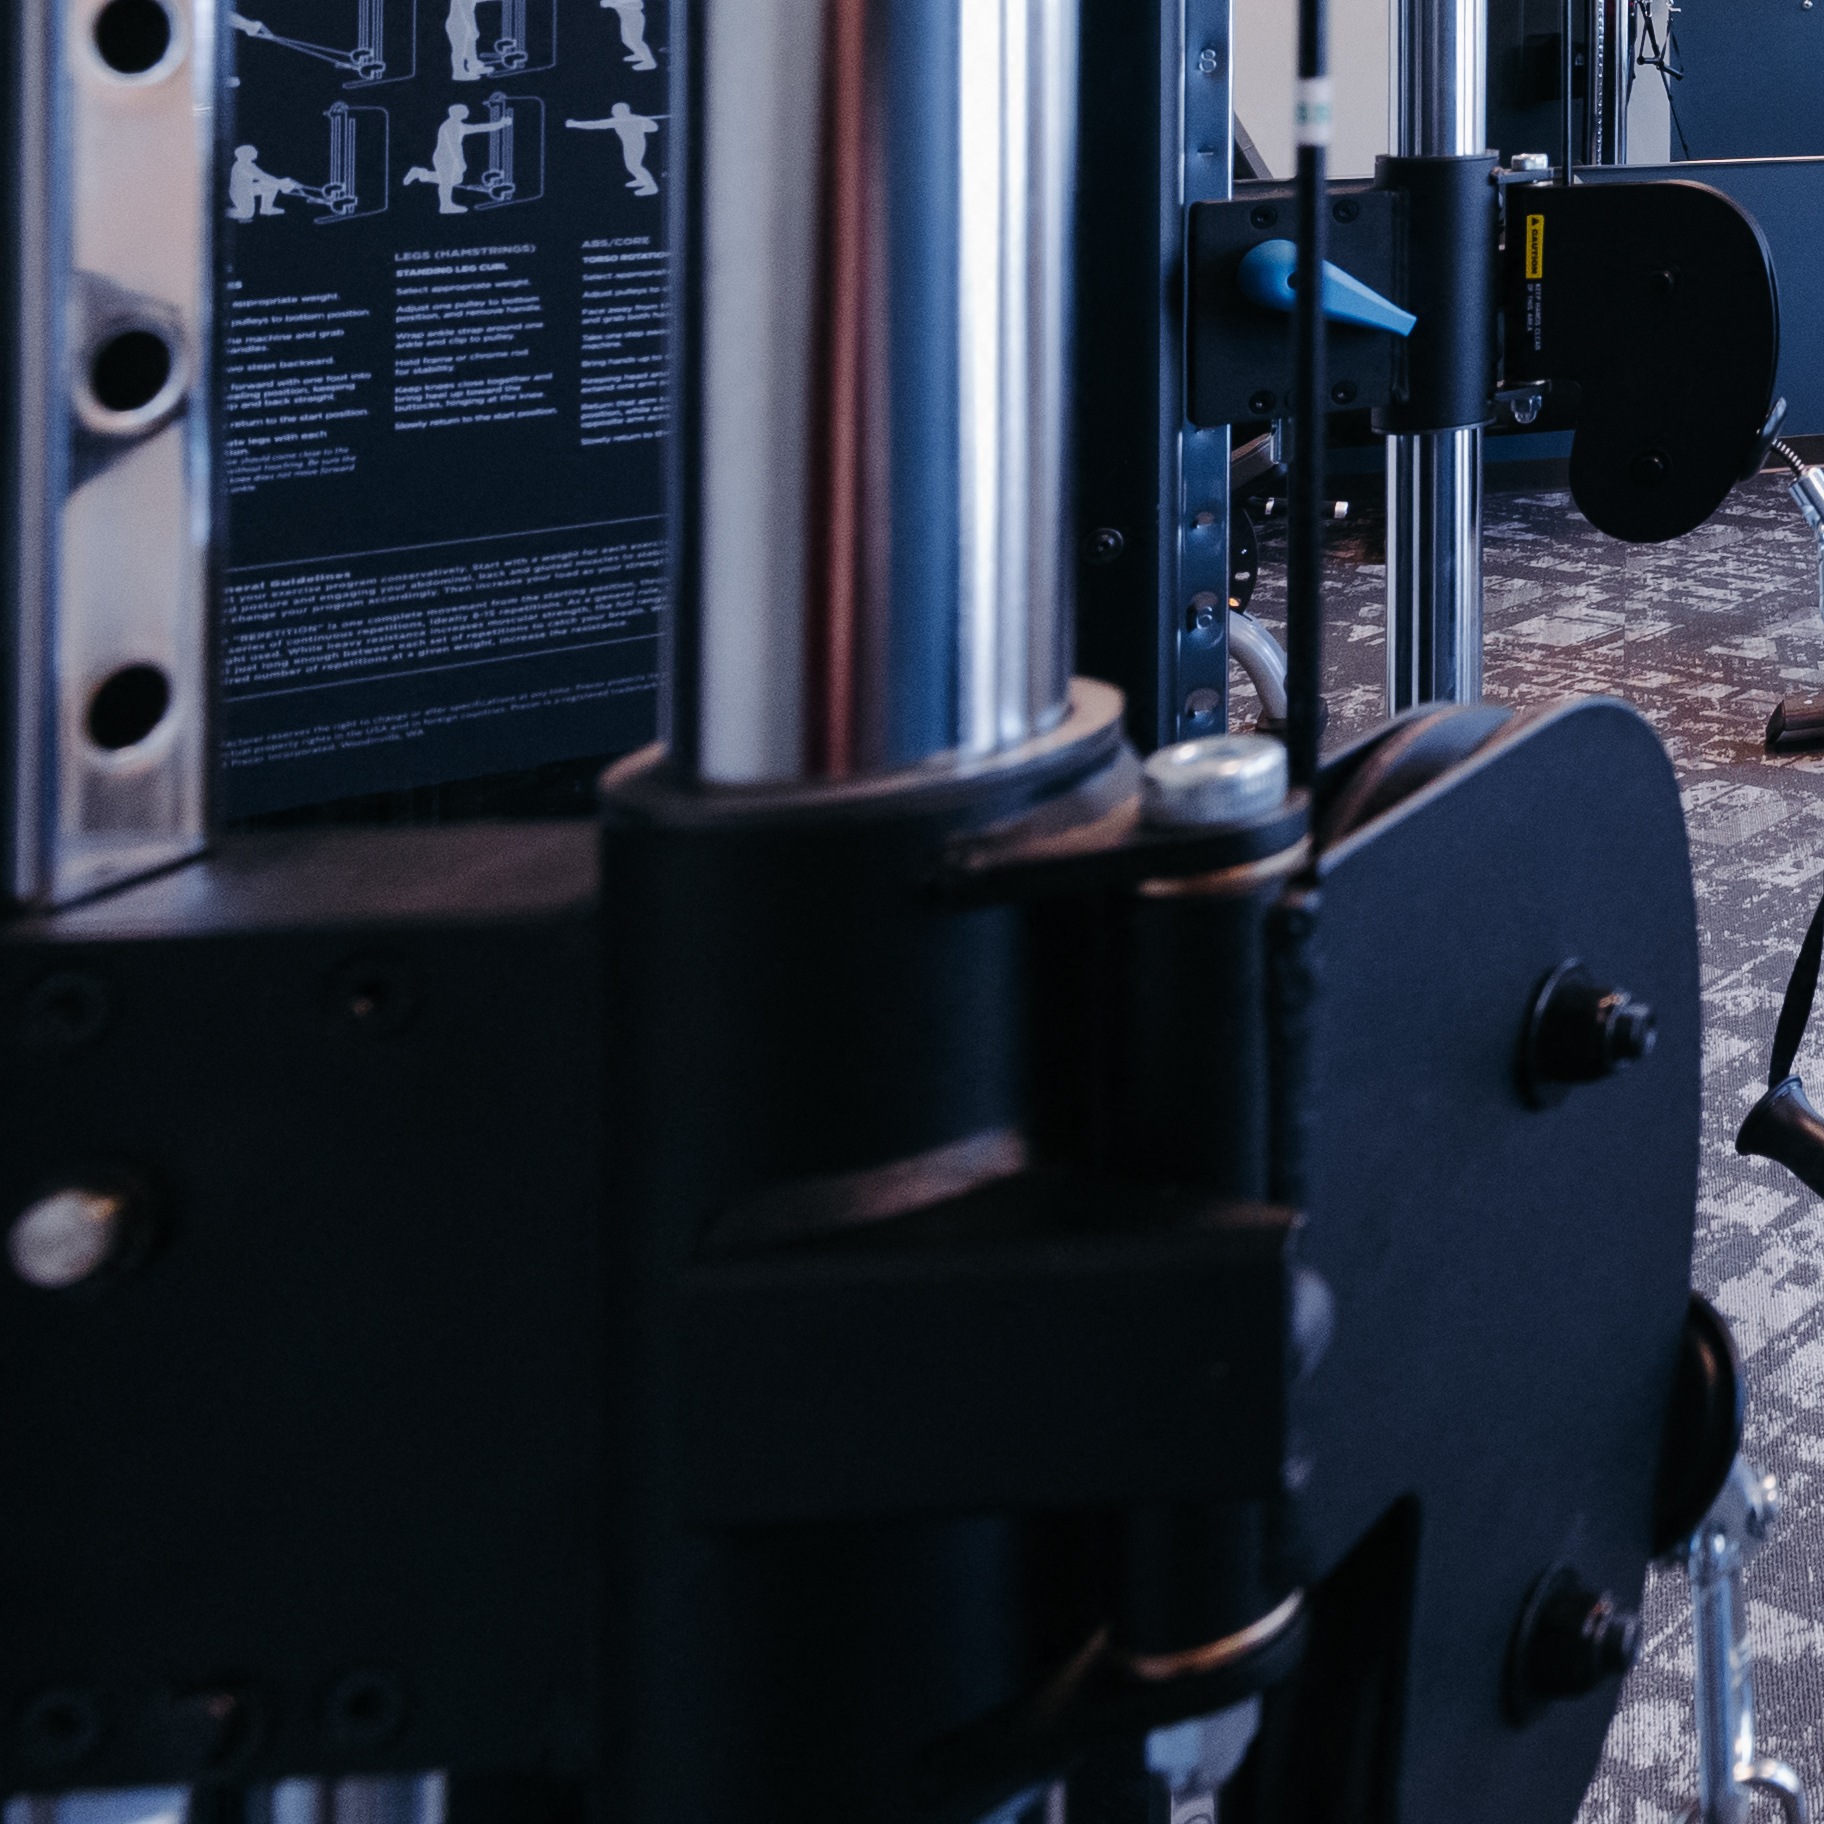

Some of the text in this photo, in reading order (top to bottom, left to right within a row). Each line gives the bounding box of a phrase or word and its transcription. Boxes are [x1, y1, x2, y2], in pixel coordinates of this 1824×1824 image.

[1198, 48, 1218, 74] 8
[582, 236, 650, 249] ABS/CORE
[1531, 228, 1539, 275] CAUTION
[394, 244, 536, 262] LEGS (HAMSTRINGS)
[620, 252, 671, 261] ROTATIO
[396, 262, 507, 277] STANDING LEG CURL
[1196, 605, 1213, 630] 6
